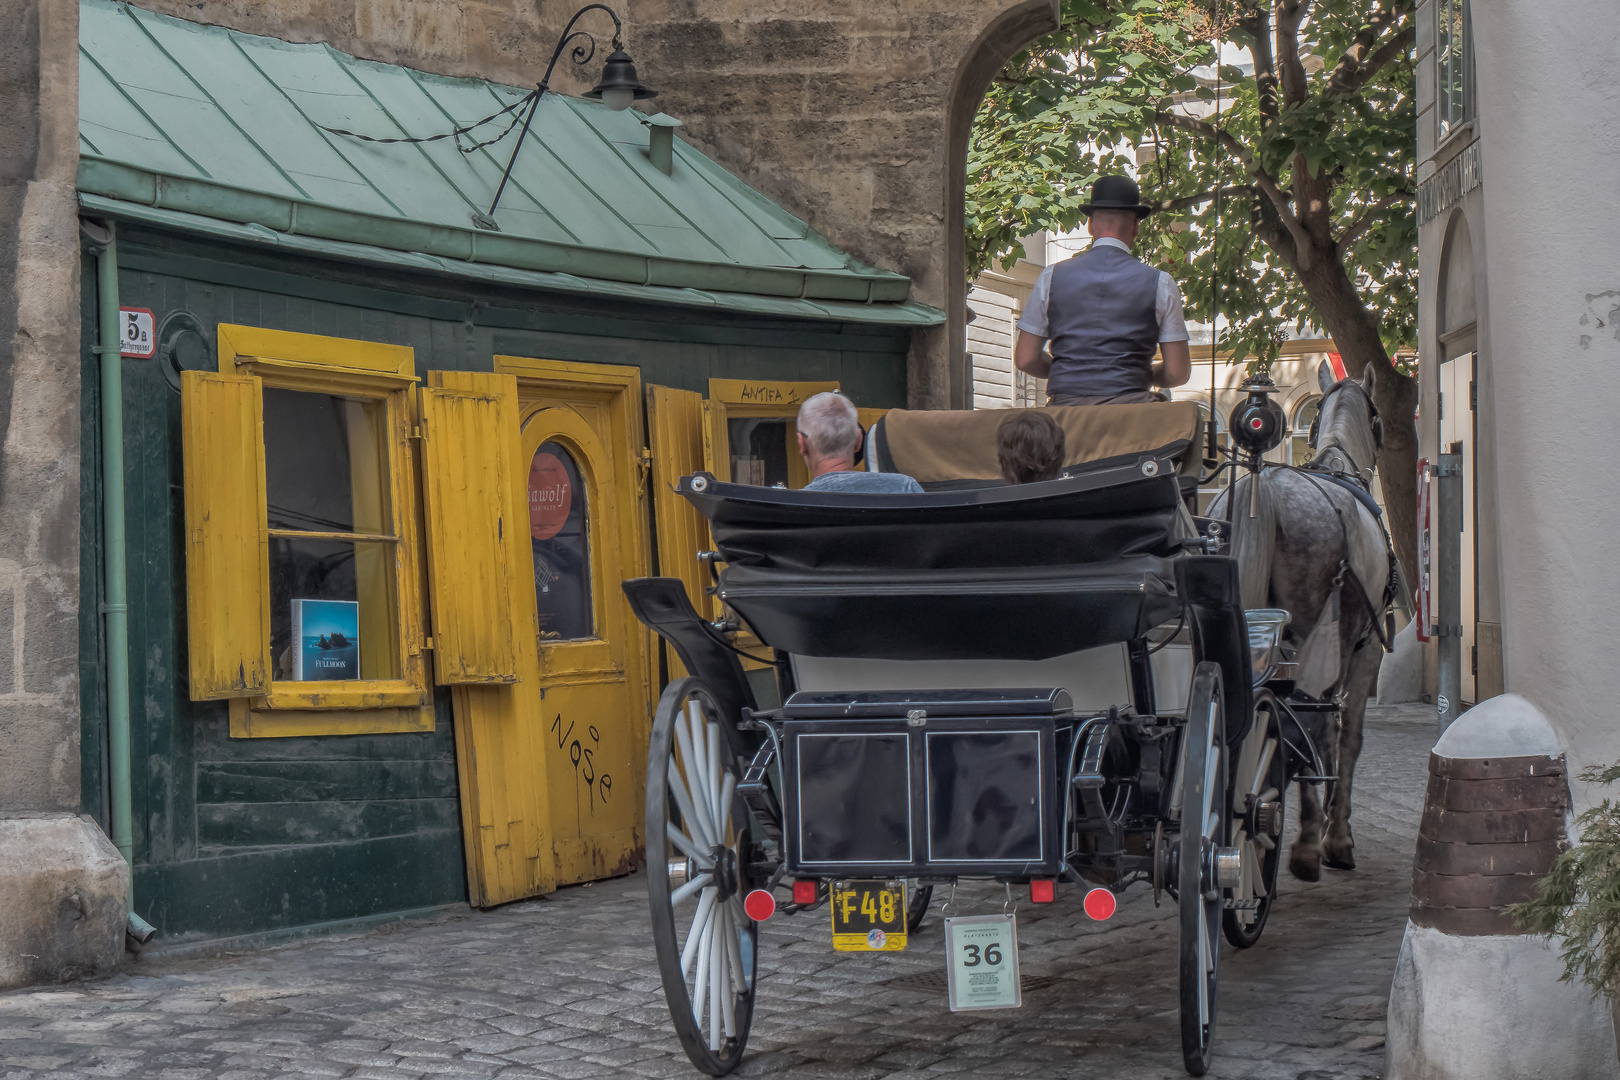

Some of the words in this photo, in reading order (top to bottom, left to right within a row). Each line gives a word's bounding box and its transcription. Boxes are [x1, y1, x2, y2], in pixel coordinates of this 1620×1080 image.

[741, 384, 783, 403] ANTIFA
[528, 484, 568, 508] iawolf
[315, 659, 346, 668] FULLMOON
[963, 943, 1003, 967] 36
